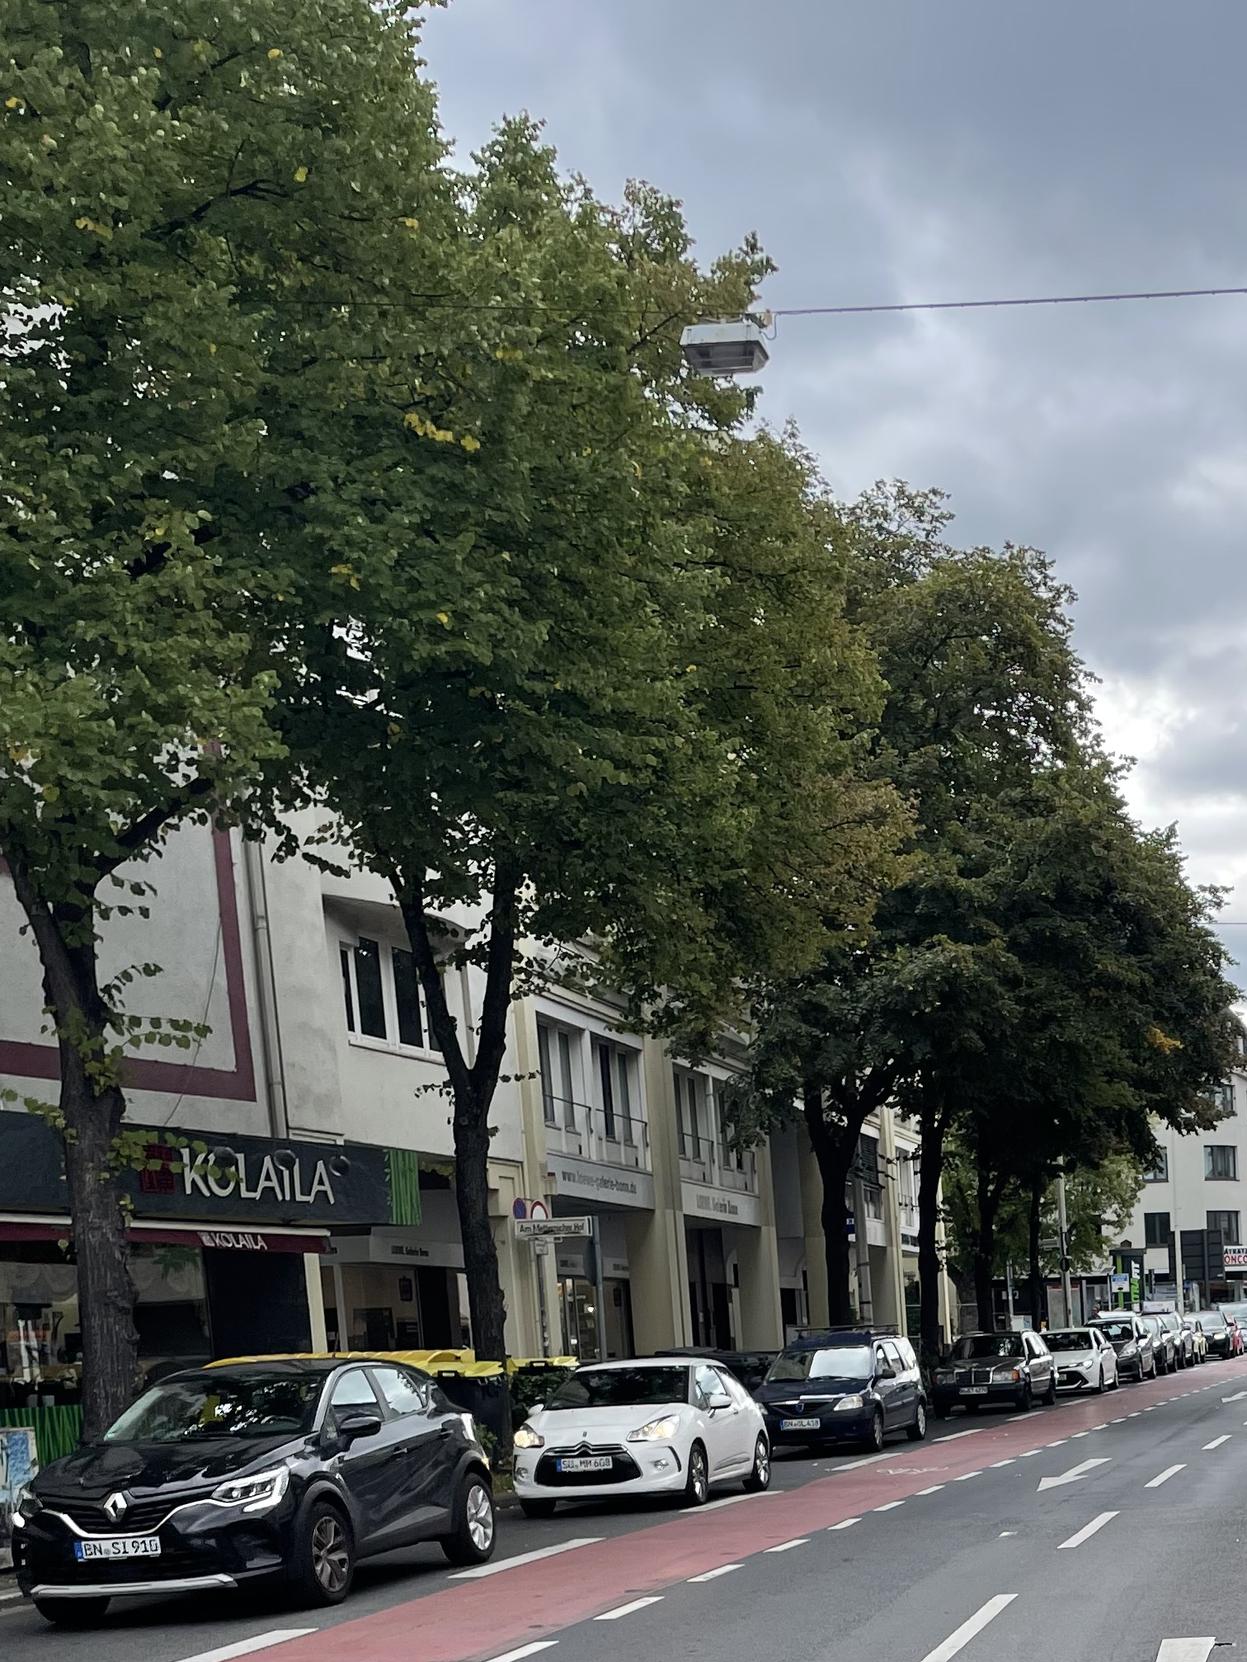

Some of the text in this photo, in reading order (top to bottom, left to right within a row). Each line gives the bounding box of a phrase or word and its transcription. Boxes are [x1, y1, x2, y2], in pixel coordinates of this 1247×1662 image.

[520, 1224, 531, 1233] Am
[574, 1222, 585, 1231] Hof
[84, 1539, 158, 1557] BN SI 910
